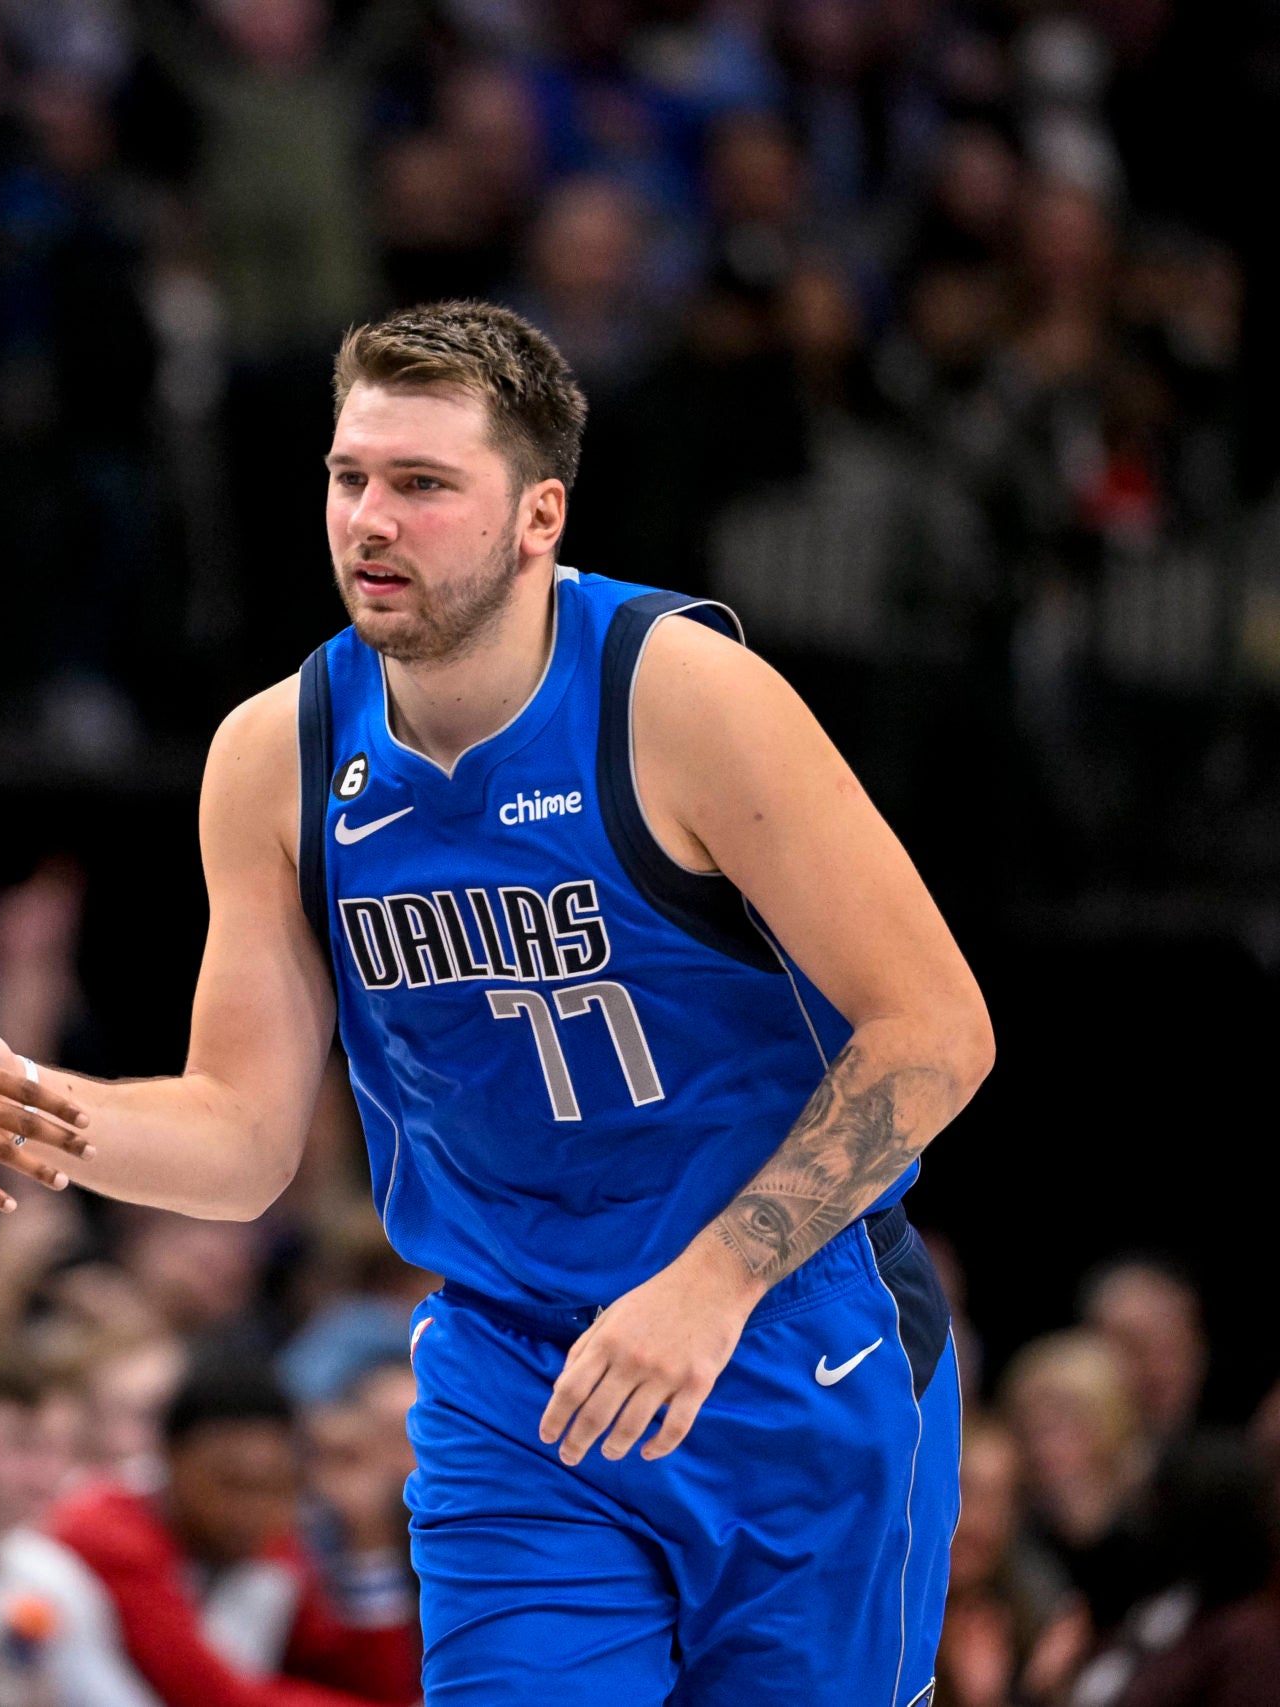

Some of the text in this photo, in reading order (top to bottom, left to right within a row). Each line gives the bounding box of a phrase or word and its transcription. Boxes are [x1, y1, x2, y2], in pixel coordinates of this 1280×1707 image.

[339, 759, 366, 796] 6
[499, 790, 583, 826] chime
[337, 879, 611, 990] DALLAS
[485, 980, 665, 1122] 77
